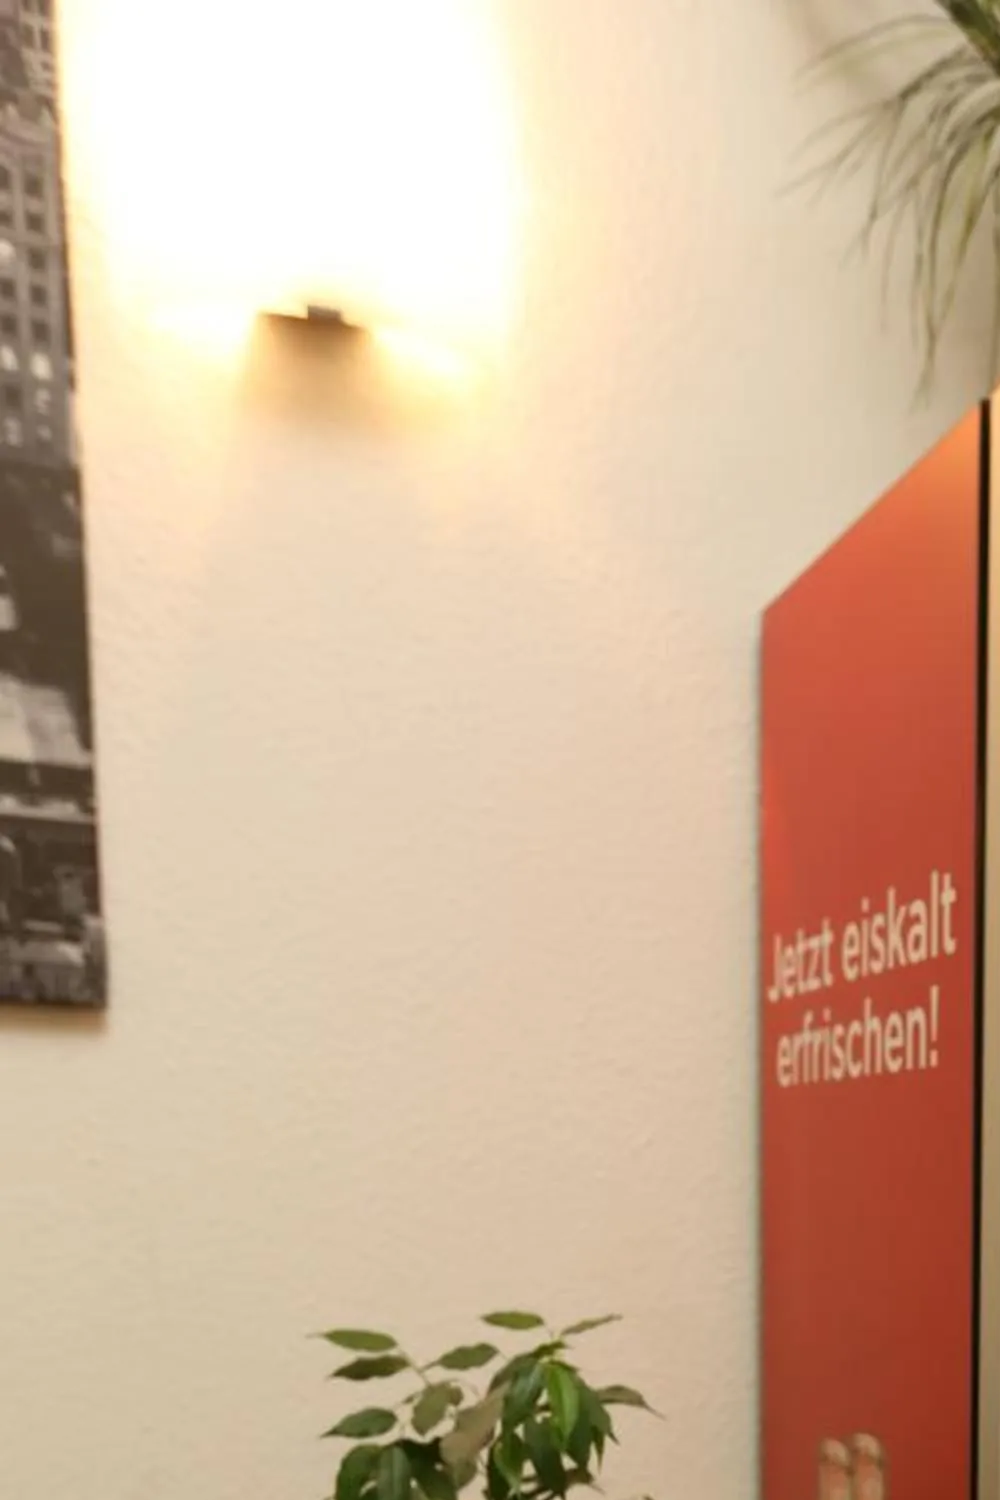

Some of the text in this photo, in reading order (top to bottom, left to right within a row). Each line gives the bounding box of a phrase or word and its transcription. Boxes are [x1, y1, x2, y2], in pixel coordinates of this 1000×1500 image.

[768, 869, 958, 1003] Jetzt eiskalt
[776, 984, 940, 1088] erfrischen!
